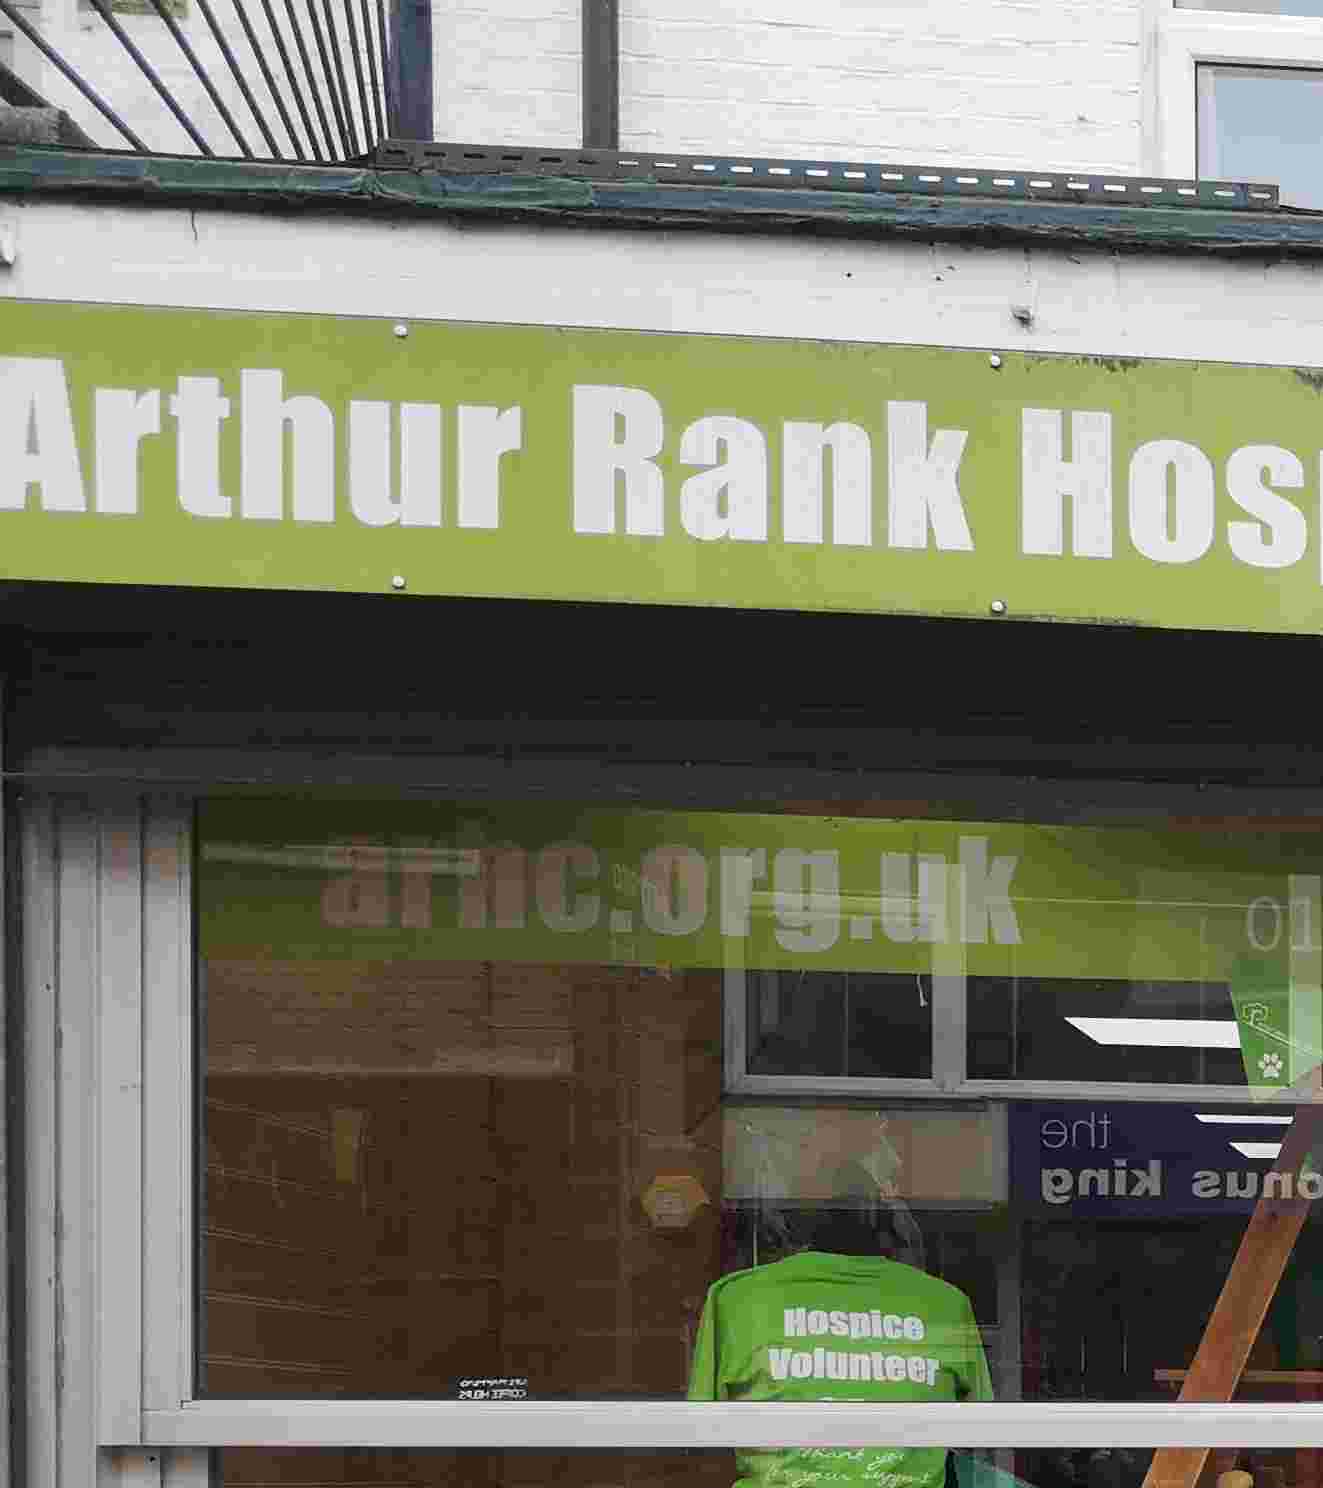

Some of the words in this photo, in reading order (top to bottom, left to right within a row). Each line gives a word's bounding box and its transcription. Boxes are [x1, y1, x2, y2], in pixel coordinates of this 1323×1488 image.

[0, 355, 521, 529] Arthur
[573, 384, 973, 551] Rank
[783, 1307, 926, 1342] Hospice
[767, 1347, 941, 1387] Volunteer
